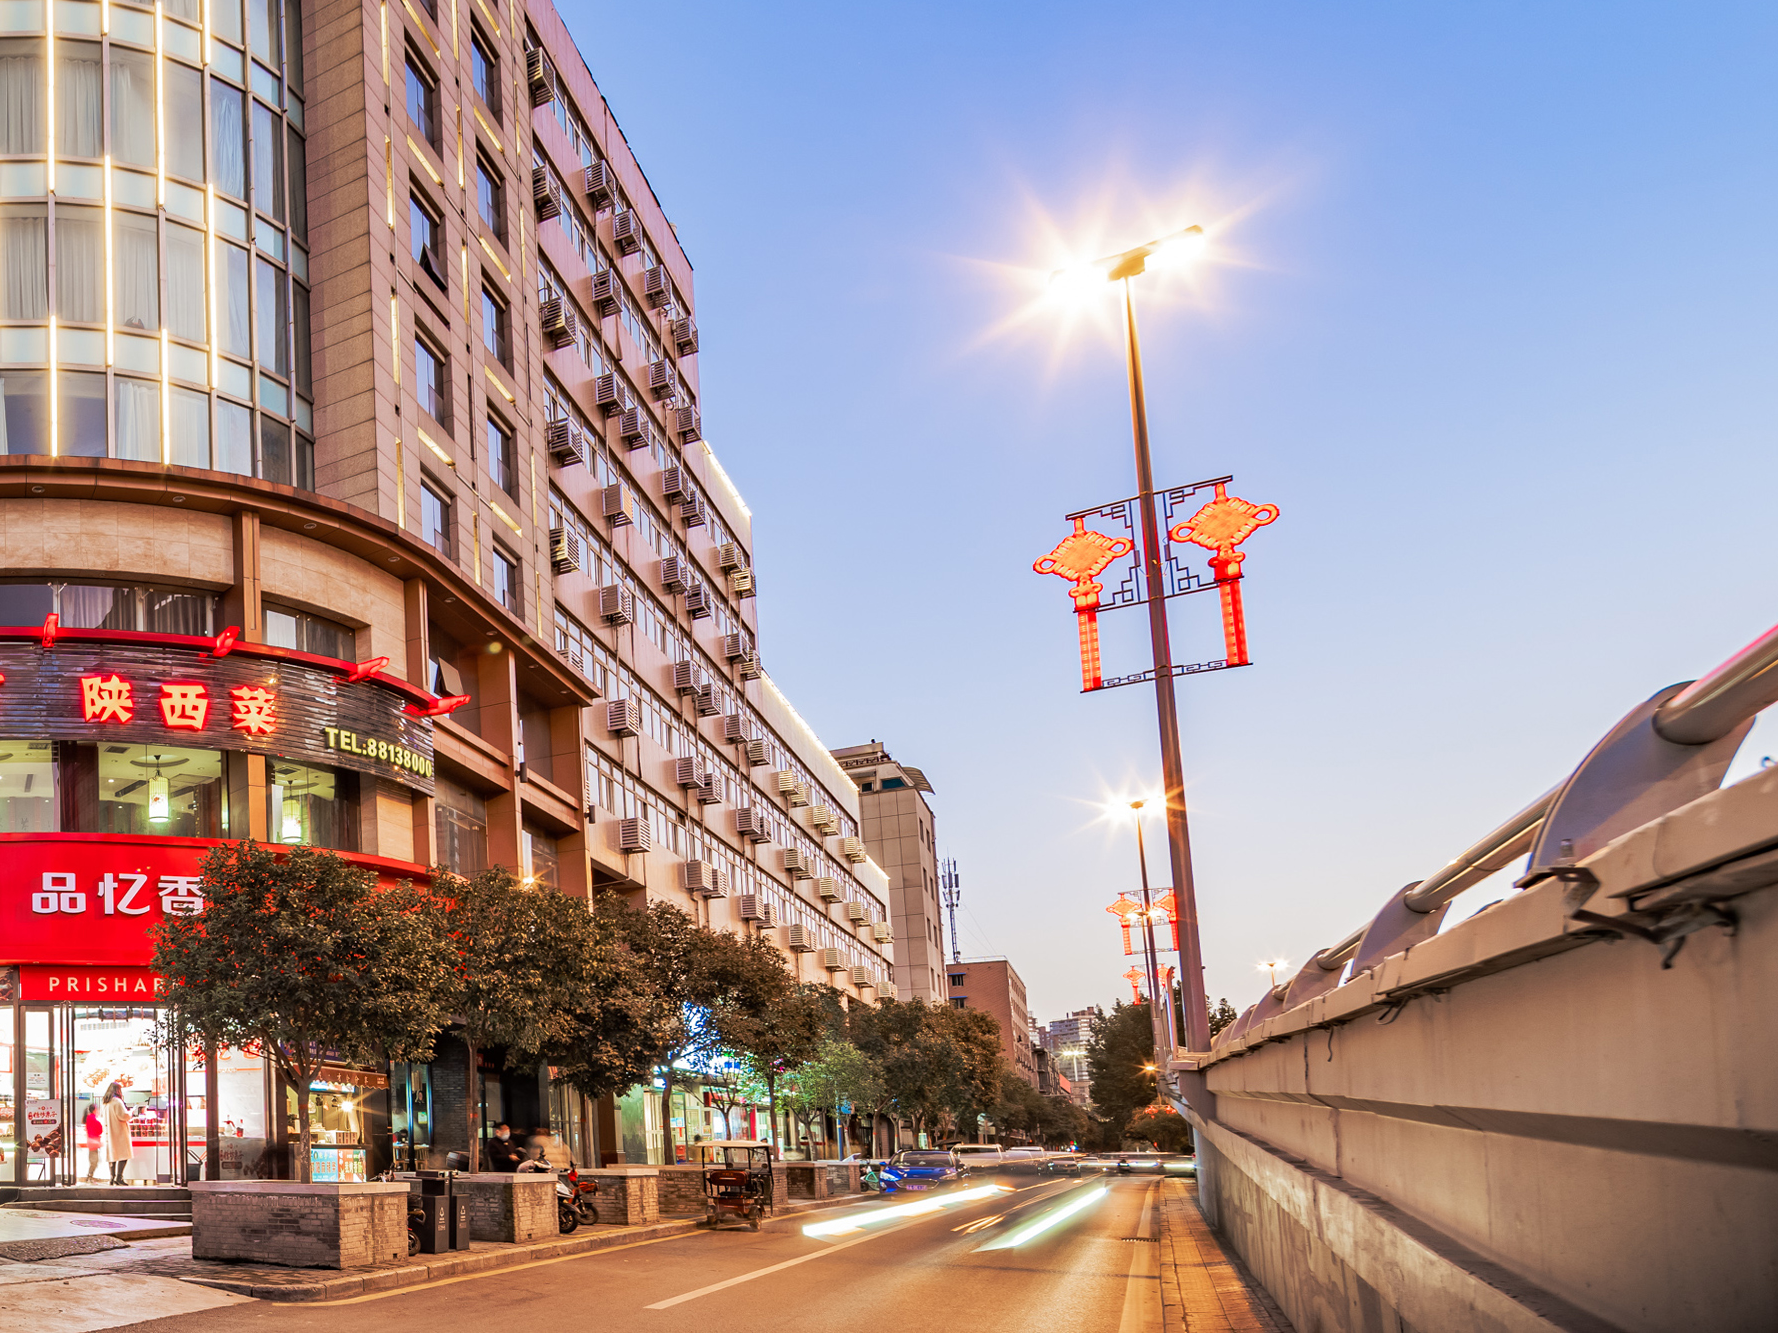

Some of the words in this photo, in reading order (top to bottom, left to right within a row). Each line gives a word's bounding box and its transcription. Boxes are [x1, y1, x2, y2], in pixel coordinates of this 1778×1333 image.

[81, 674, 278, 735] 陕西菜
[324, 726, 432, 777] TEL:88138000
[32, 872, 205, 916] 品忆香
[49, 976, 181, 993] PRISHAR
